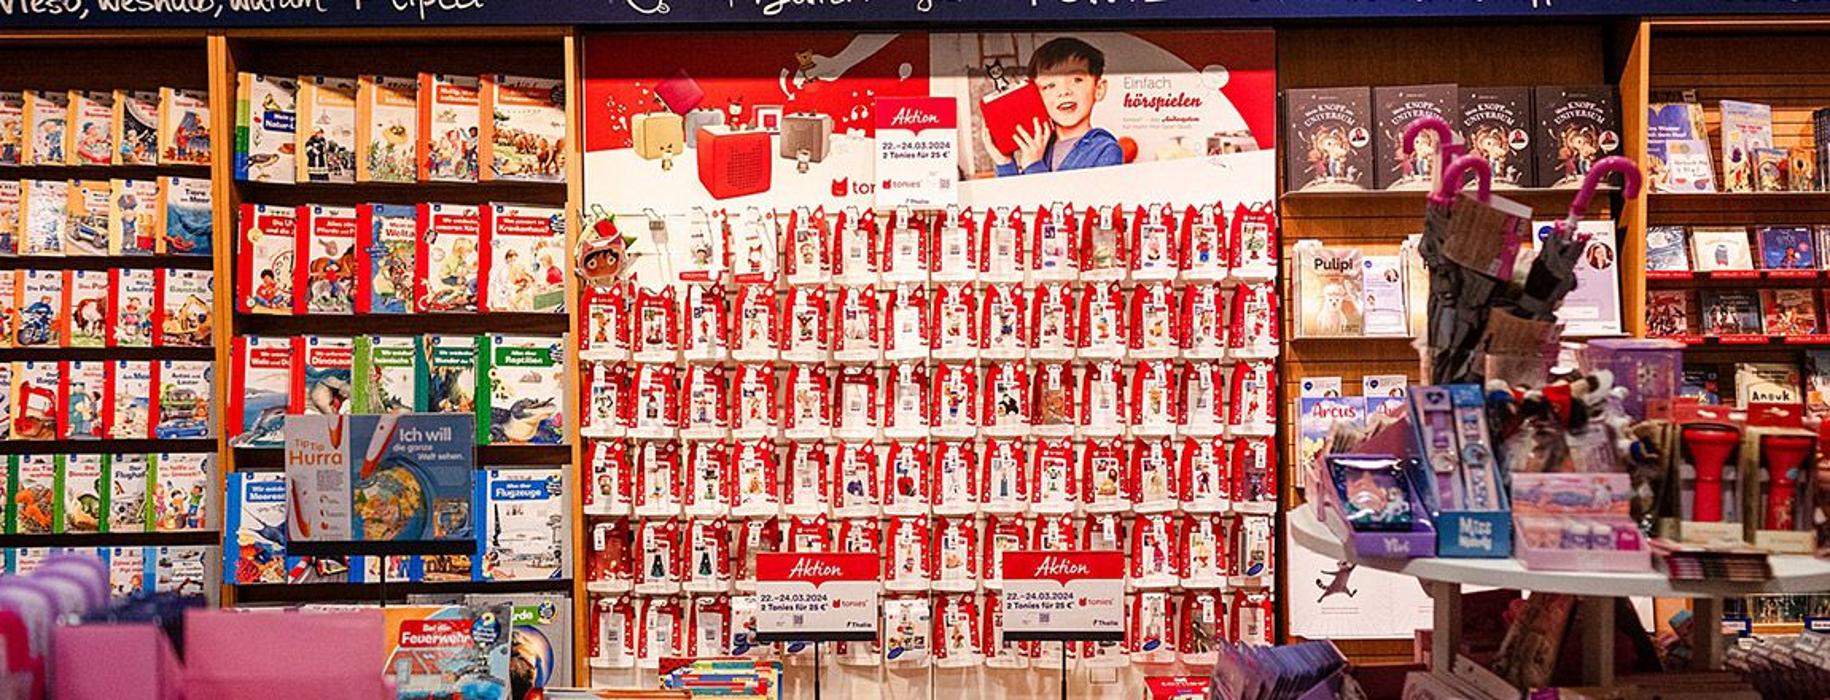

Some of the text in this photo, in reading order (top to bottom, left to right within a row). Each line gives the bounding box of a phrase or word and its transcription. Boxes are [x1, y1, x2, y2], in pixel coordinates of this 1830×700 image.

[1124, 77, 1172, 90] Einfach
[1124, 92, 1203, 112] hörspielen
[891, 107, 939, 126] Aktion
[1304, 112, 1356, 128] UNIVERSUM
[1464, 112, 1515, 127] UNIVERSUM
[1554, 110, 1606, 125] UNIVERSUM
[1752, 390, 1790, 401] Anouk
[1313, 402, 1357, 418] Arcus
[400, 428, 452, 442] Ich will
[289, 450, 343, 466] Hurra
[496, 488, 542, 498] Flugzeuge
[1460, 517, 1492, 535] Miss
[789, 558, 843, 579] Aktion
[1034, 556, 1090, 577] Aktion
[1014, 602, 1040, 610] Tonies
[1042, 602, 1053, 610] für
[402, 632, 471, 644] Feuerwehr
